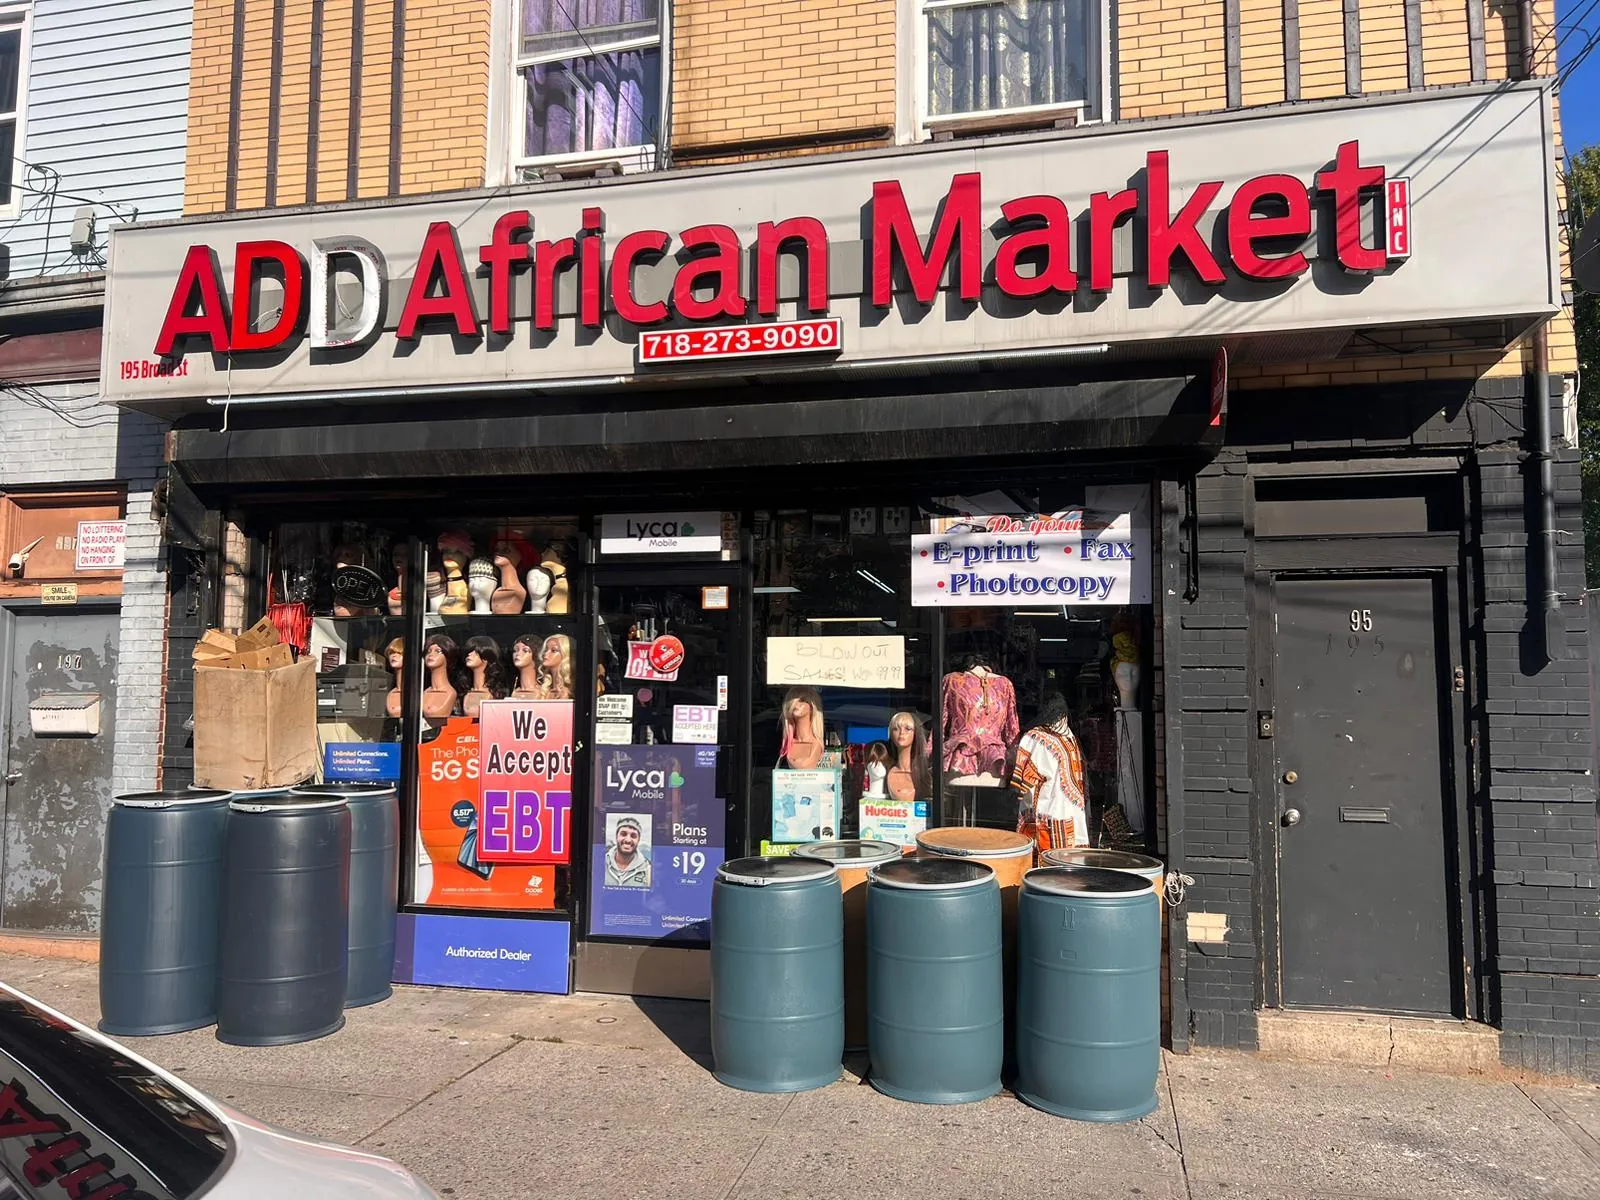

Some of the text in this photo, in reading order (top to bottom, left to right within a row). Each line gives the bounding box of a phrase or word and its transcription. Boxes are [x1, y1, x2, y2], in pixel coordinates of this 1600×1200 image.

[1391, 182, 1405, 252] INC
[153, 139, 1387, 356] ADD African Market
[646, 323, 833, 357] 718-273-9090
[120, 360, 139, 380] 195
[141, 359, 174, 379] Broad
[82, 526, 91, 534] NO
[626, 519, 678, 541] Lyca
[986, 514, 1084, 536] Do your
[81, 546, 90, 554] NO
[82, 536, 91, 544] NO
[649, 537, 678, 547] Mobile
[932, 538, 1135, 567] E-print Fax
[51, 586, 68, 595] SMILE
[336, 575, 381, 599] OPEN
[950, 572, 1116, 599] Photocopy
[1351, 609, 1373, 631] 95
[796, 642, 891, 660] BLOW OUT
[58, 654, 82, 670] 197
[511, 708, 548, 741] We
[675, 706, 717, 723] EBT
[431, 747, 454, 758] The
[486, 744, 573, 782] Accept
[431, 759, 463, 781] 5G
[606, 765, 665, 792] Lyca
[631, 789, 665, 799] Mobile
[482, 789, 573, 854] EBT
[865, 805, 908, 818] HUGGIES
[672, 823, 707, 837] Plans
[672, 836, 707, 846] Starting at
[767, 844, 790, 856] SAVE
[672, 851, 706, 875] $19
[445, 945, 532, 962] Authorized Dealer
